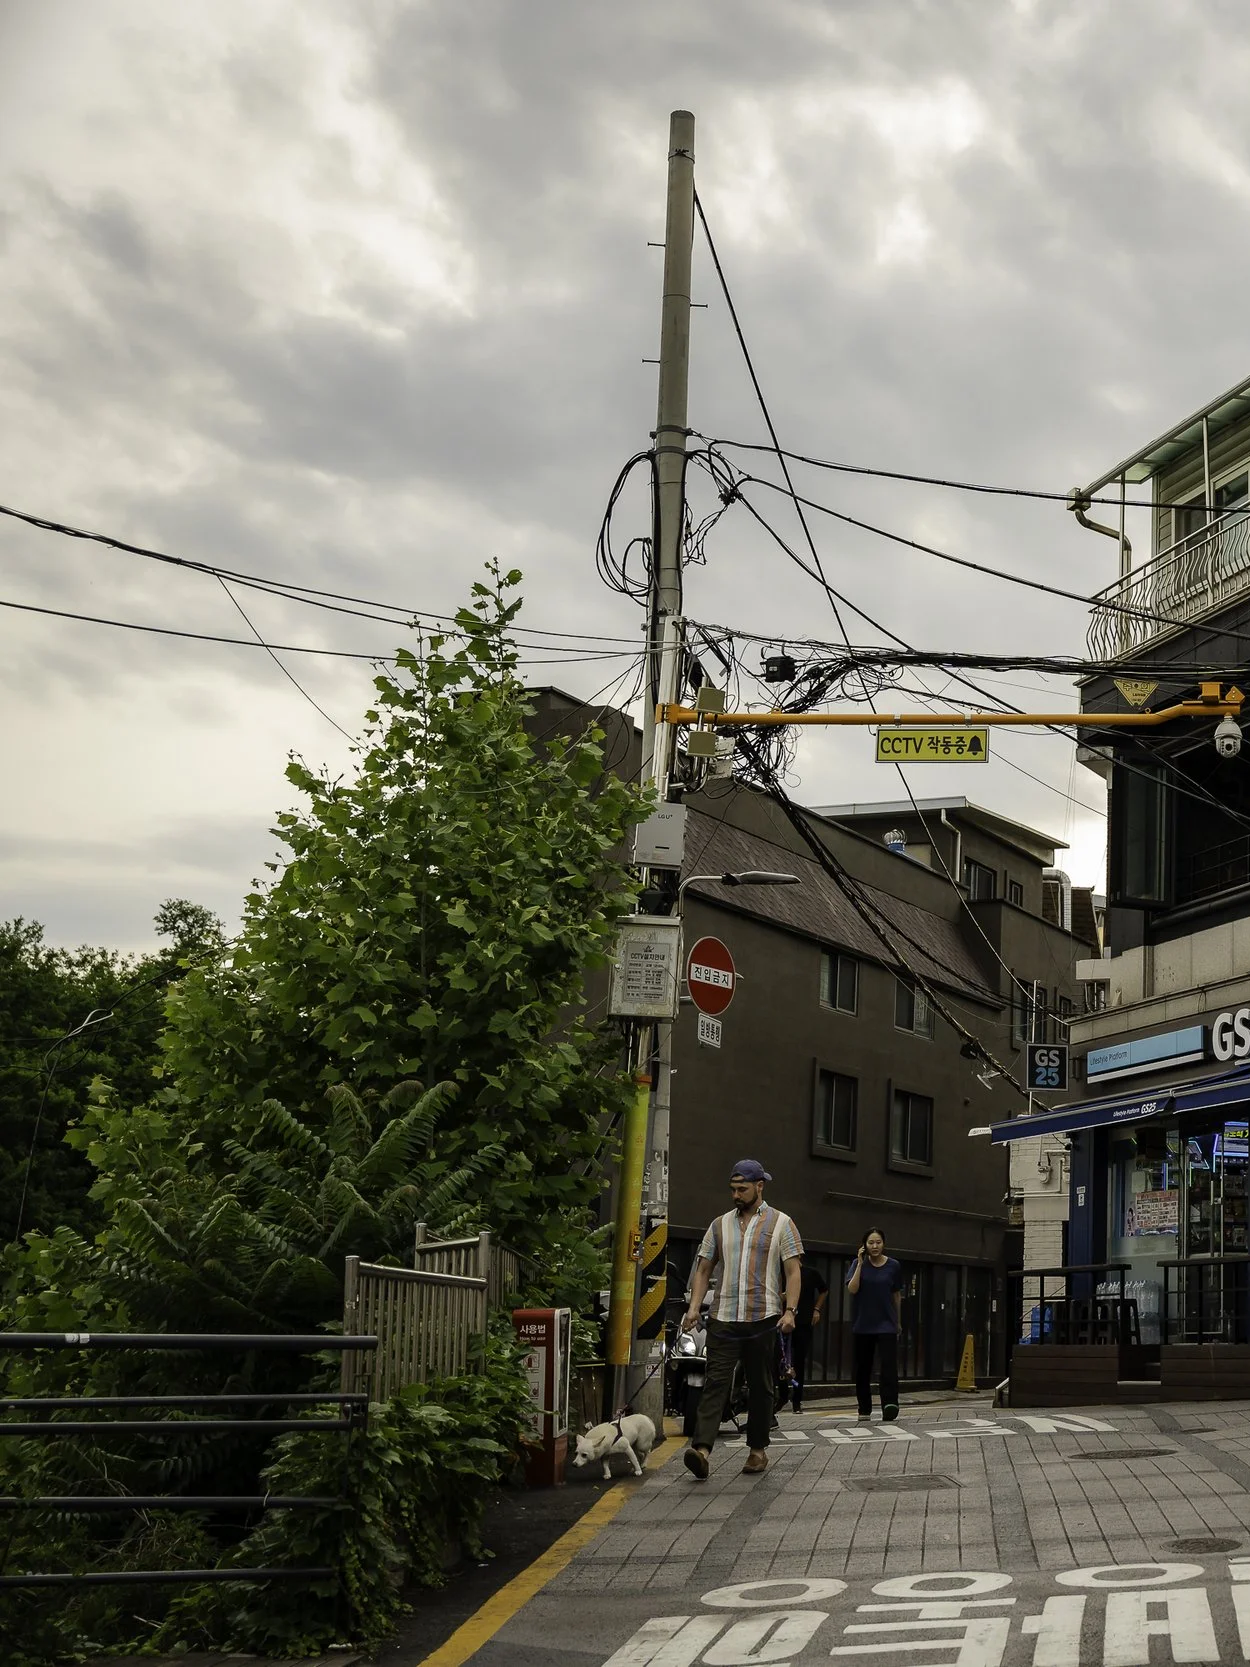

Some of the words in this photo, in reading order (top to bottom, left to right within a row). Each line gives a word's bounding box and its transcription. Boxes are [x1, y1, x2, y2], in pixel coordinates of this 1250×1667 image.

[880, 737, 924, 754] CCTV
[926, 735, 968, 755] 작동중
[694, 966, 729, 987] 진입금지
[700, 1020, 721, 1043] 일방통행
[1034, 1049, 1060, 1067] GS
[1089, 1054, 1109, 1066] Lifestyle
[1109, 1050, 1128, 1062] Platform
[1034, 1067, 1060, 1086] 25
[1140, 1101, 1157, 1114] GS25
[519, 1324, 546, 1335] 사용법
